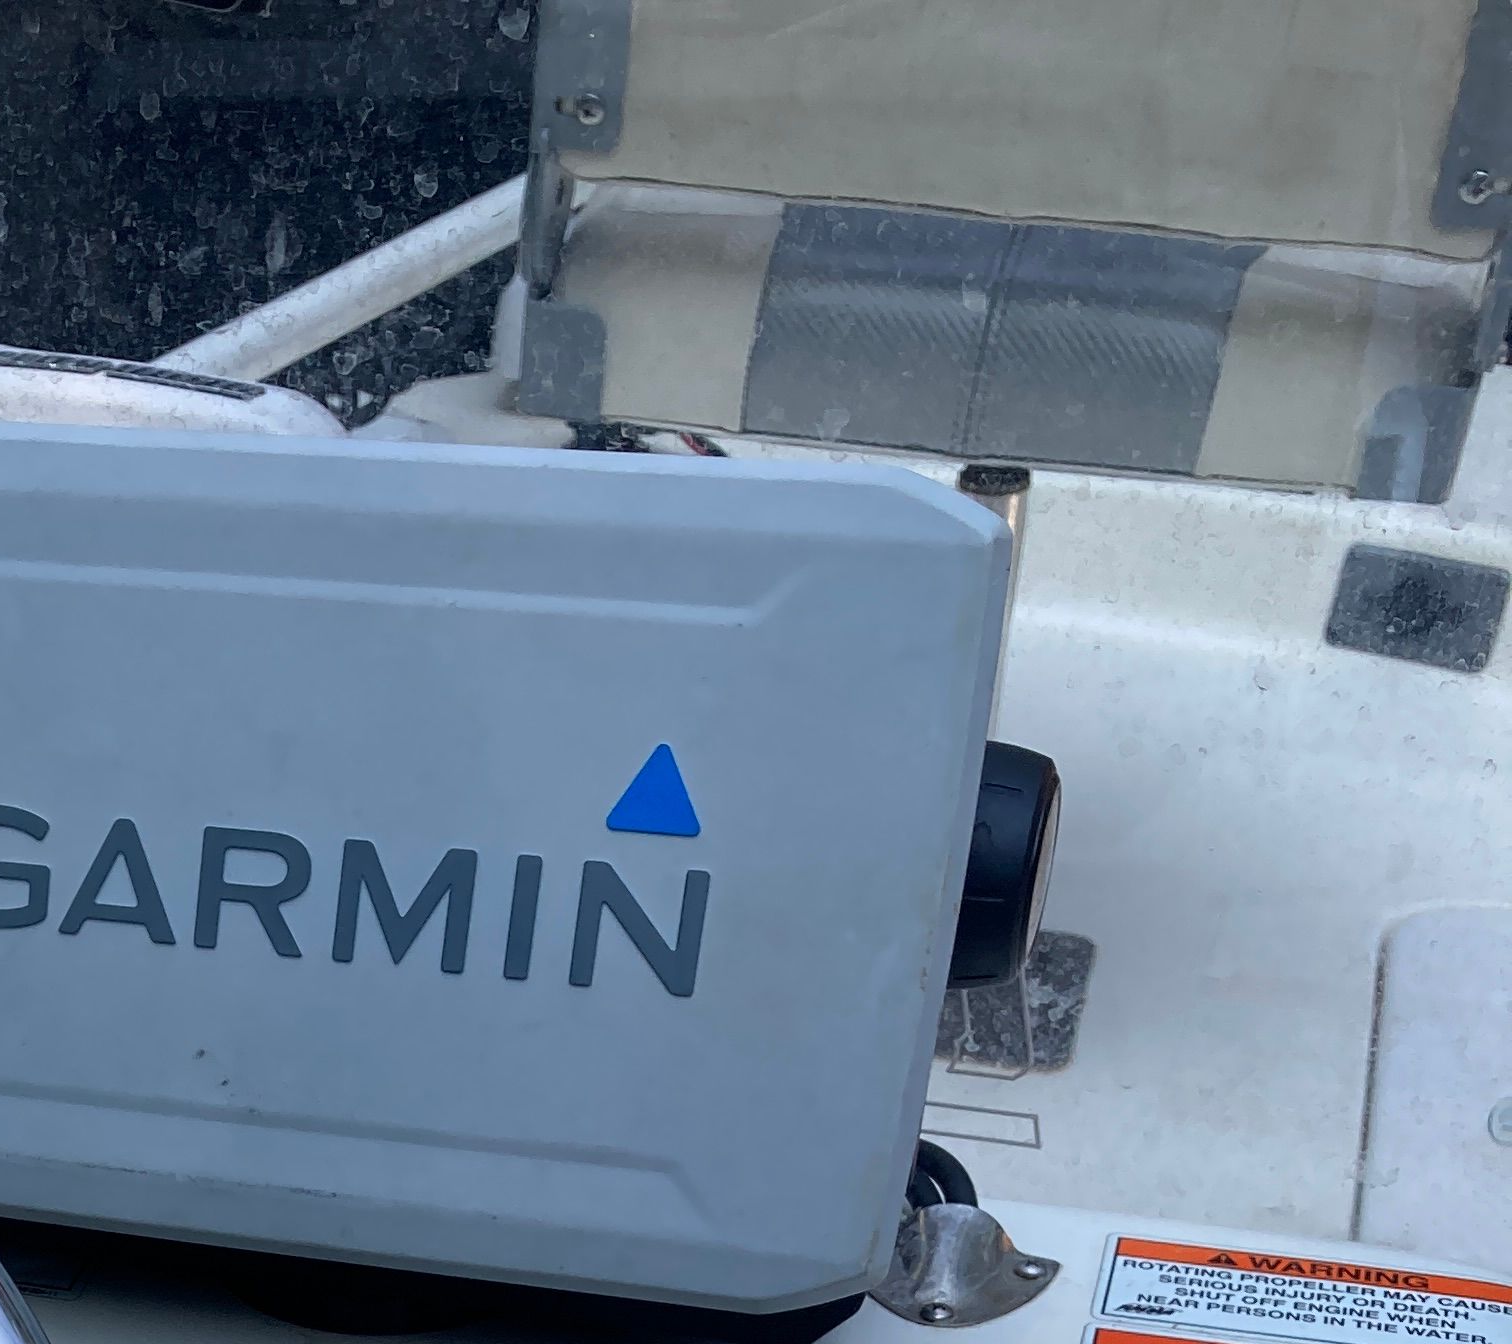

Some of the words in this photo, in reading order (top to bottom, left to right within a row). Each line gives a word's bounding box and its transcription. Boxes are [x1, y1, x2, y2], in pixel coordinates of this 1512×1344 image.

[1123, 1258, 1233, 1280] ROTATING
[1240, 1273, 1376, 1297] PROPELLER
[1383, 1289, 1431, 1303] MAY
[1437, 1297, 1512, 1315] CAUSE
[1248, 1255, 1430, 1290] WARNING
[1137, 1293, 1199, 1309] NEAR
[1206, 1302, 1316, 1324] PERSONS
[1323, 1316, 1346, 1327] IN
[1352, 1319, 1398, 1335] THE
[1158, 1273, 1258, 1294] SERIOUS
[1265, 1286, 1345, 1304] INJURY
[1352, 1297, 1386, 1309] OR
[1393, 1302, 1476, 1321] DEATH.
[1175, 1287, 1236, 1302] SHUT
[1241, 1295, 1286, 1308] OFF
[1293, 1301, 1380, 1320] ENGINE
[1387, 1312, 1456, 1330] WHEN
